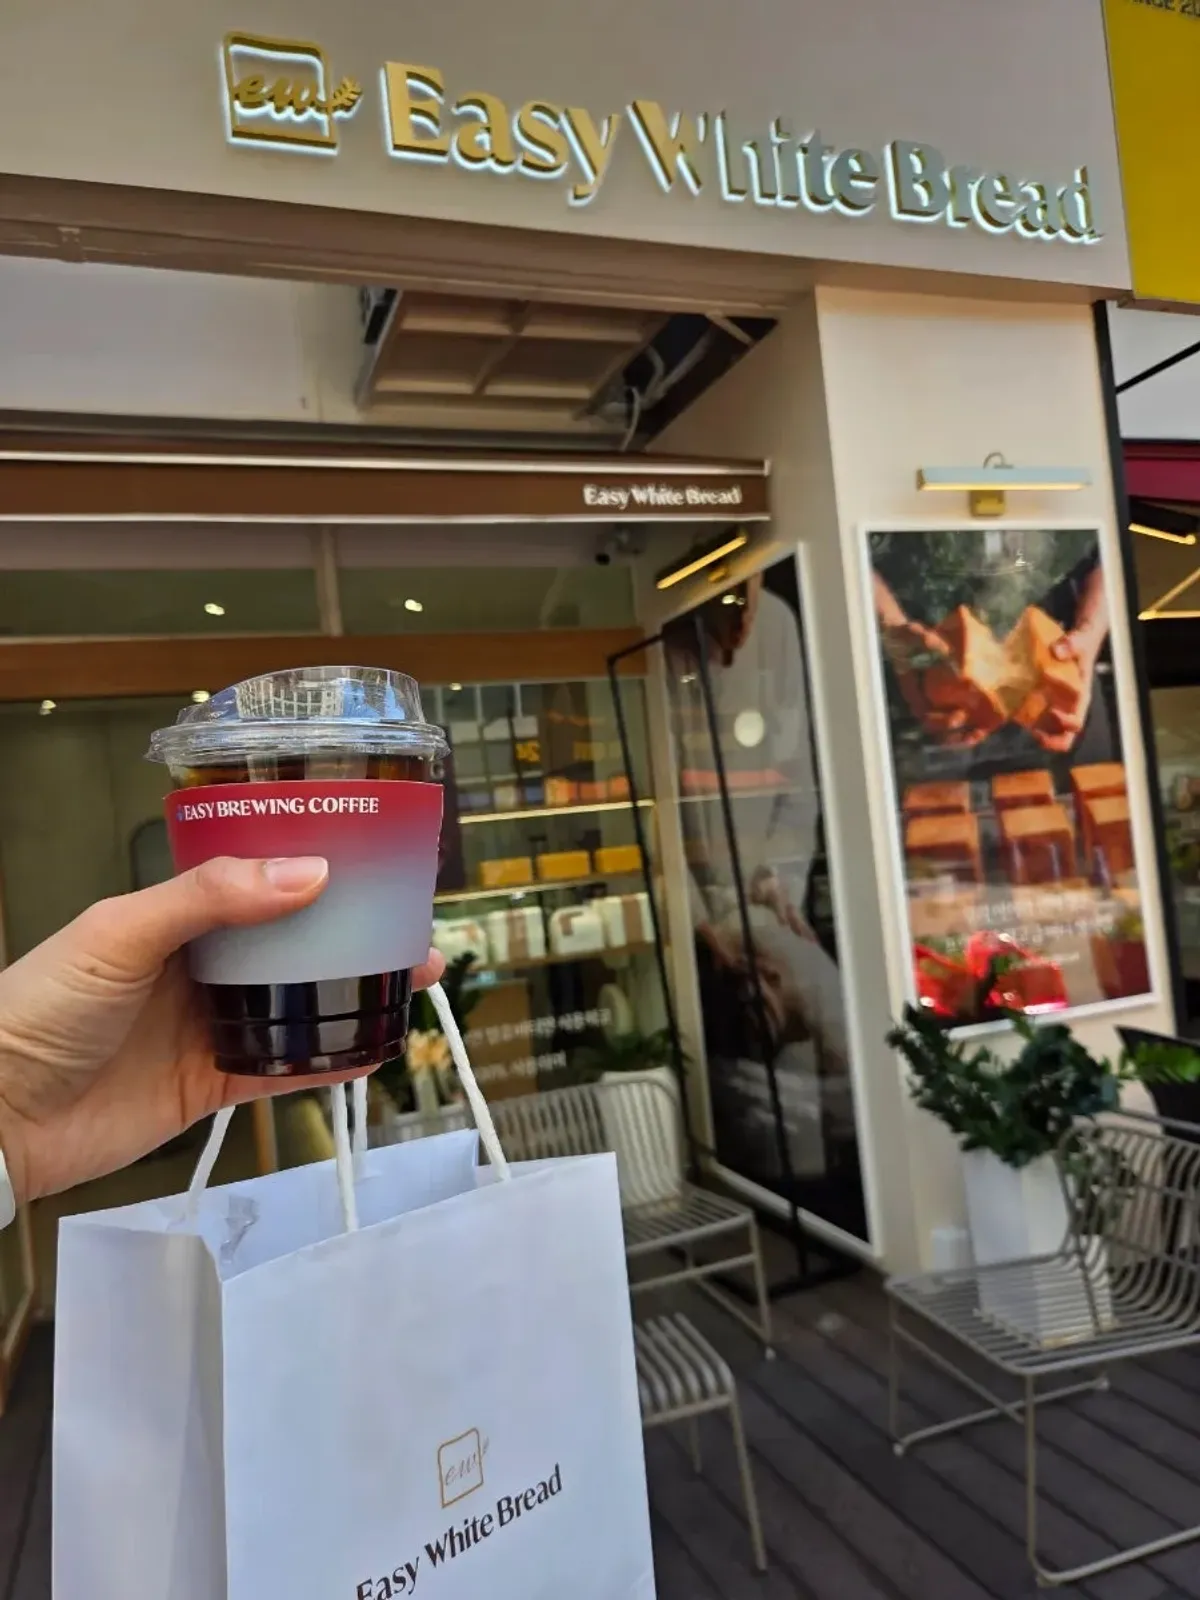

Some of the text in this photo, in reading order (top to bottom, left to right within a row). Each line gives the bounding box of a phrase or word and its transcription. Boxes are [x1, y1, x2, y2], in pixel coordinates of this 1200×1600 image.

[381, 60, 1104, 244] Easy White Bread
[583, 482, 742, 510] Easy White Bread
[184, 796, 380, 821] EASY BREWING COFFEE
[356, 1462, 563, 1600] Easy White Bread
